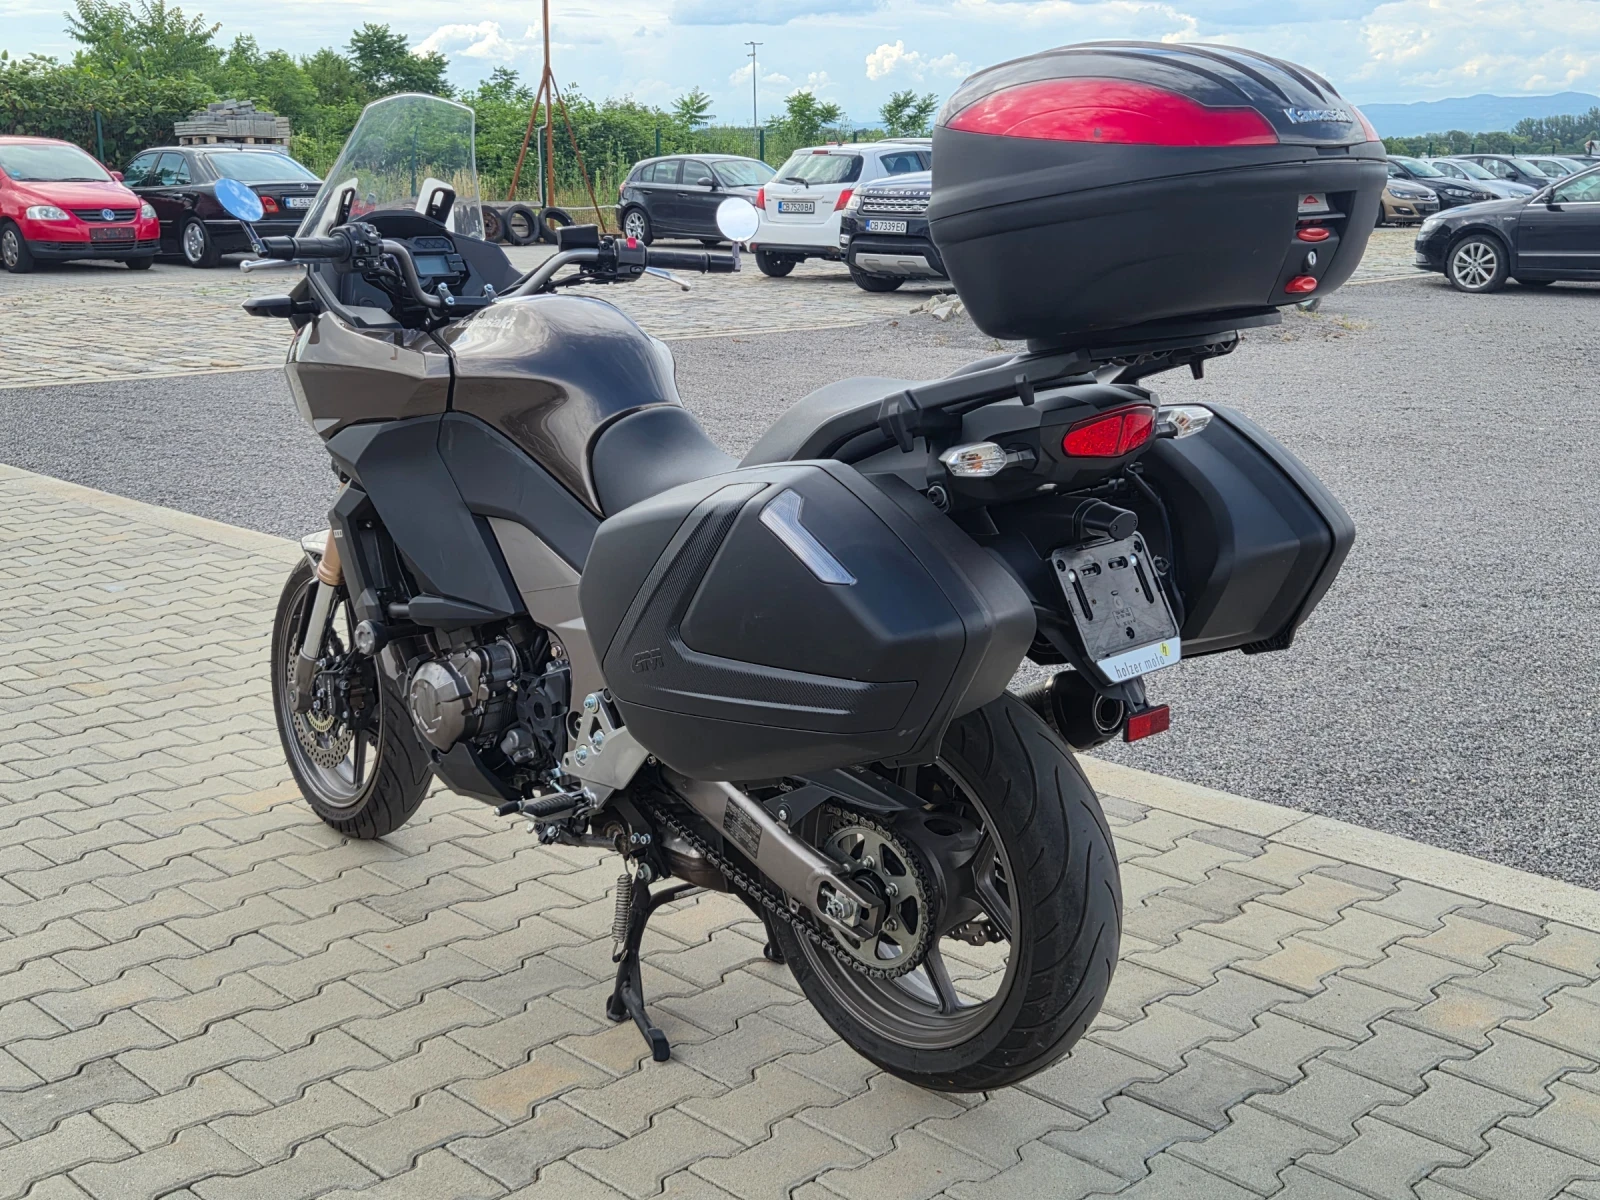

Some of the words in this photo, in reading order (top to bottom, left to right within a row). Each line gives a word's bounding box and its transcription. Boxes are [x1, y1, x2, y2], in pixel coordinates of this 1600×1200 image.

[1283, 108, 1353, 124] Kawasaki
[1114, 662, 1143, 679] holzer
[1144, 652, 1166, 670] moto
